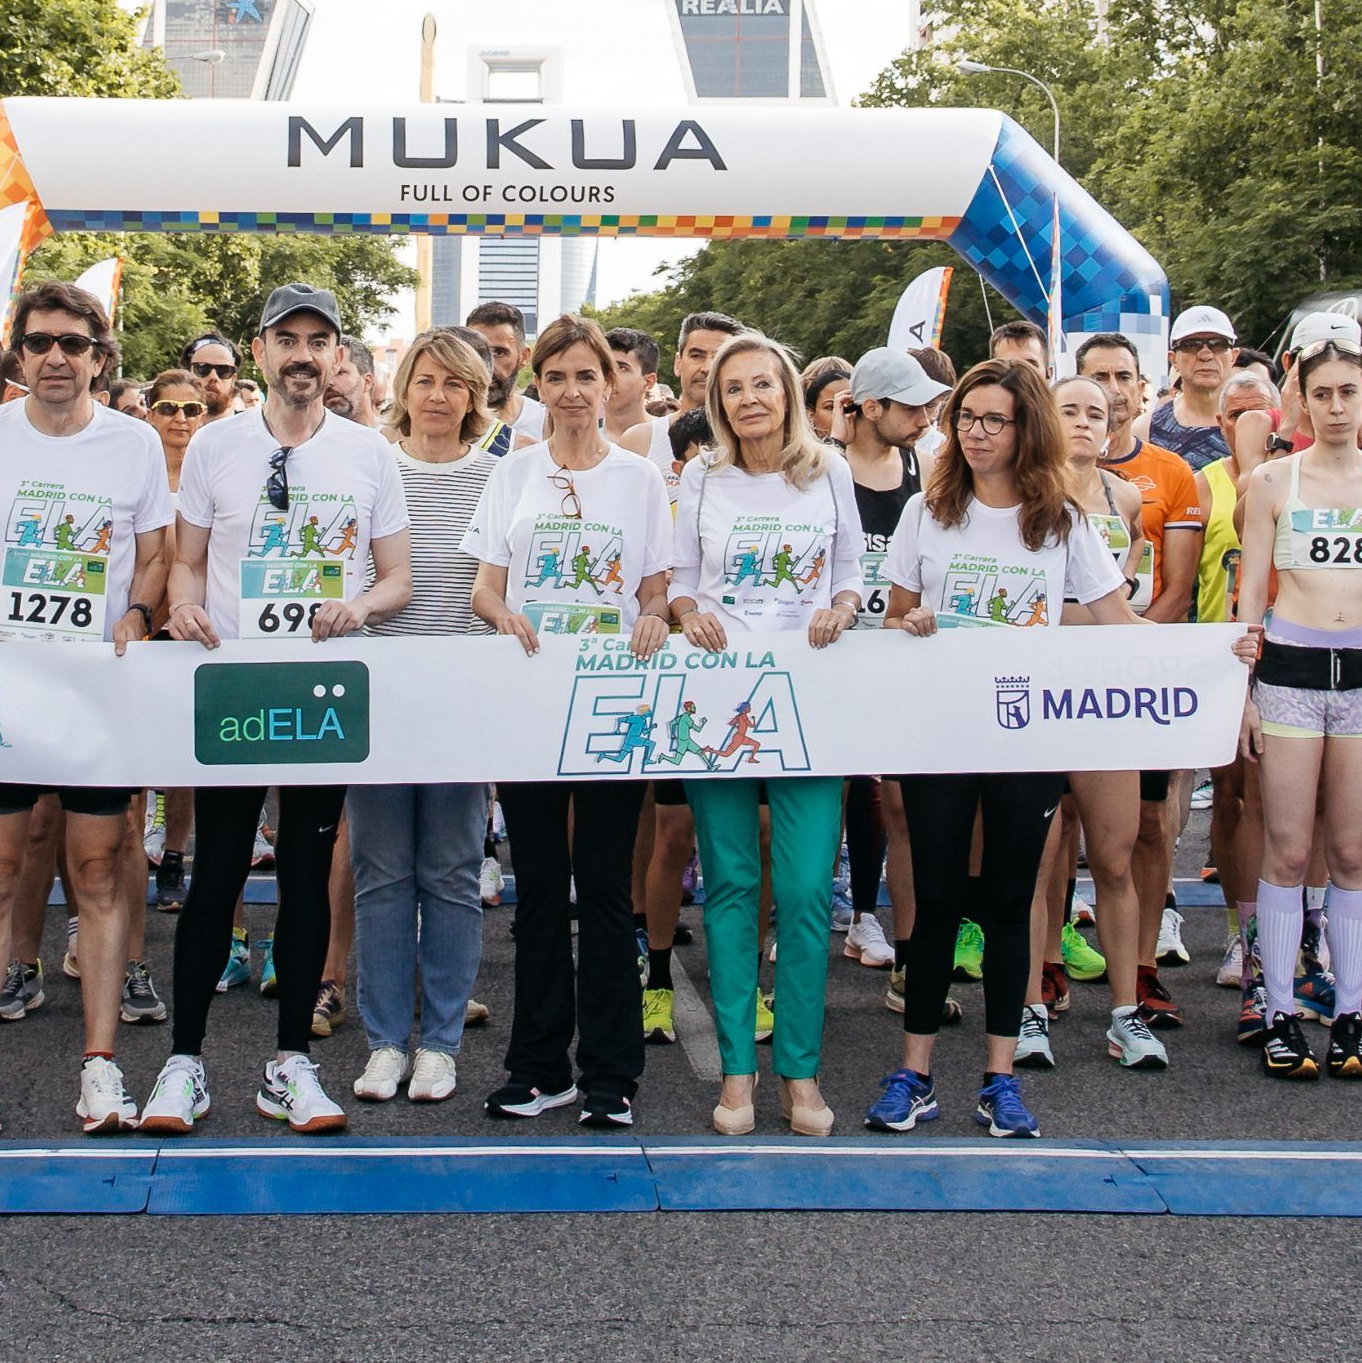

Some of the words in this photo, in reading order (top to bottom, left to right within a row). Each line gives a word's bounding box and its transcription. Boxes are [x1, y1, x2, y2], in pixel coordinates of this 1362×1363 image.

[288, 116, 727, 171] MUKUA
[400, 184, 454, 203] FULL
[462, 184, 493, 203] OF
[501, 185, 616, 204] COLOURS
[31, 480, 65, 489] Carrera
[17, 489, 67, 500] MADRID
[69, 493, 96, 502] CON
[98, 496, 113, 506] LA
[312, 493, 338, 502] CON
[340, 494, 355, 503] LA
[534, 522, 581, 531] MADRID
[584, 523, 609, 533] CON
[611, 527, 623, 537] LA
[732, 524, 782, 532] MADRID
[785, 524, 811, 532] CON
[813, 526, 825, 534] LA
[964, 553, 998, 563] Carrera
[23, 558, 86, 588] ELA
[949, 562, 999, 573] MADRID
[1001, 565, 1028, 574] CON
[1031, 568, 1046, 576] LA
[262, 569, 322, 595] ELA
[8, 591, 92, 628] 1278
[684, 651, 739, 671] CON
[746, 650, 776, 669] LA
[1042, 687, 1199, 726] MADRID
